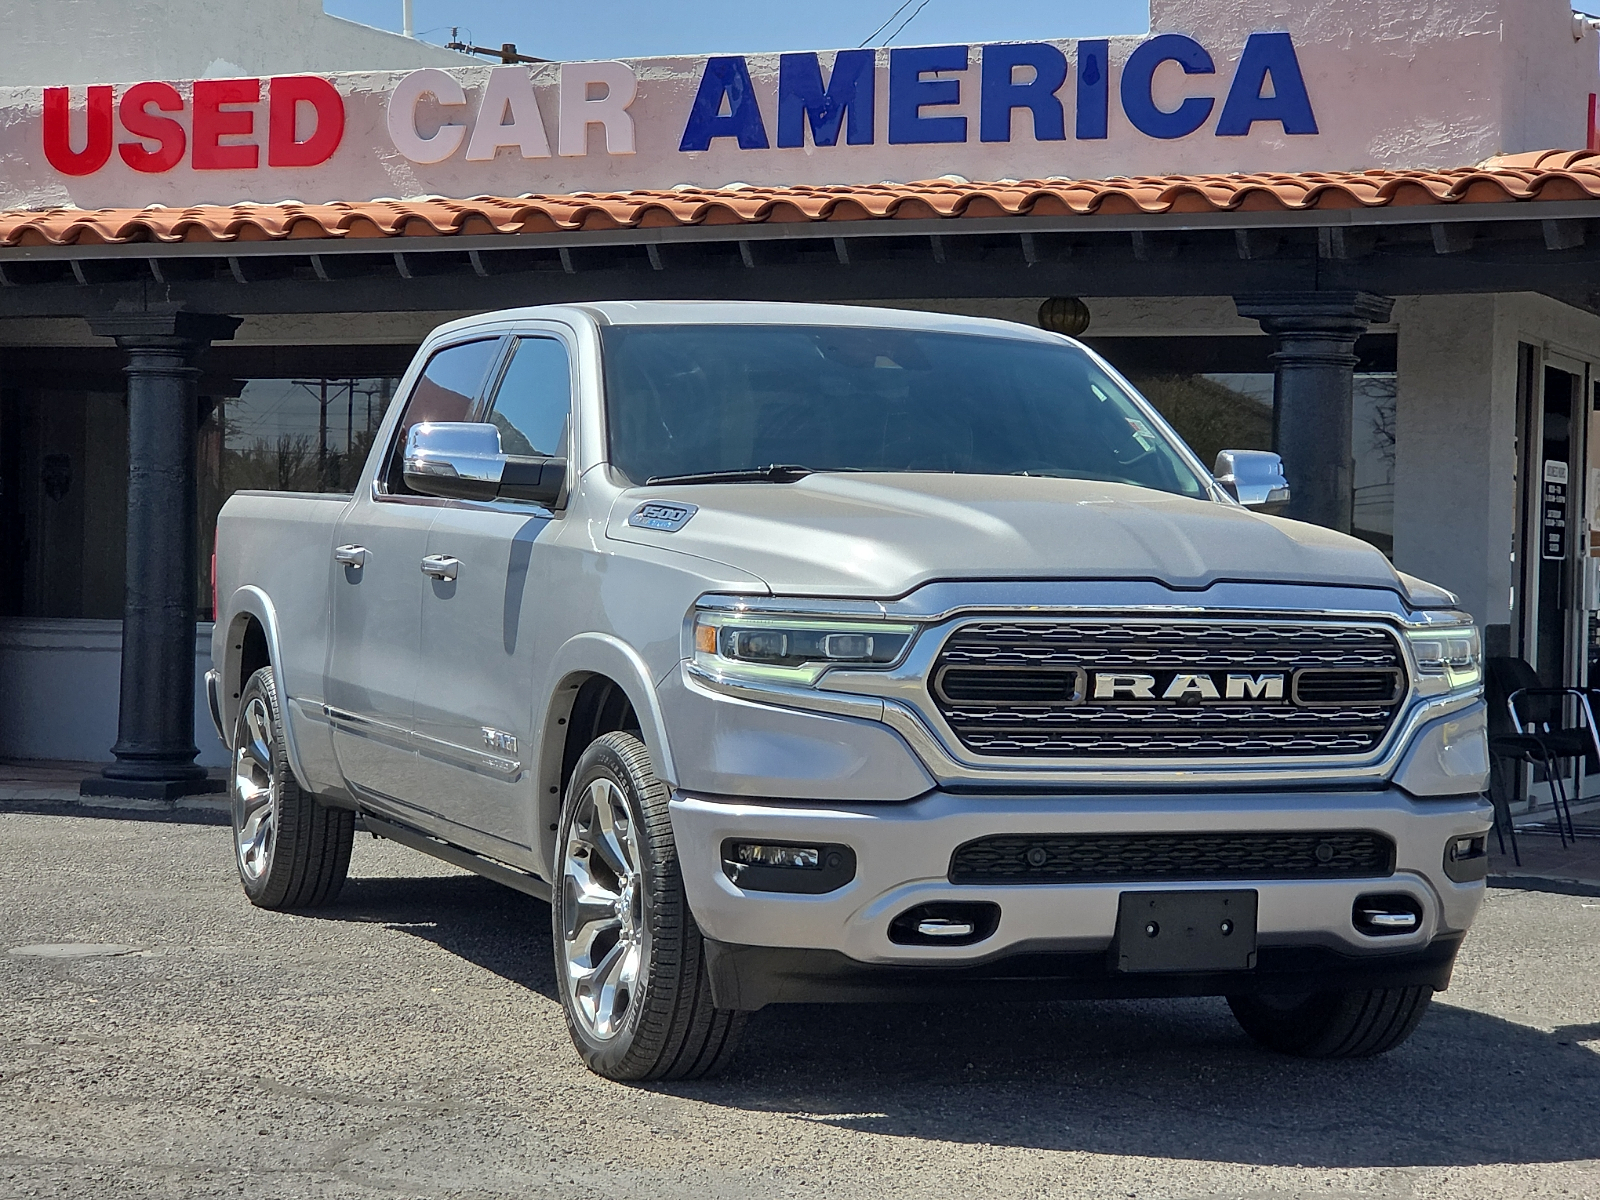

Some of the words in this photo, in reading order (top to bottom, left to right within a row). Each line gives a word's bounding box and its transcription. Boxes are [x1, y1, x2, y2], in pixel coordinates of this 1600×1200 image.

[43, 77, 345, 176] USED
[387, 61, 638, 164] CAR
[679, 33, 1319, 152] AMERICA
[641, 506, 687, 521] 1500
[1094, 672, 1285, 699] RAM
